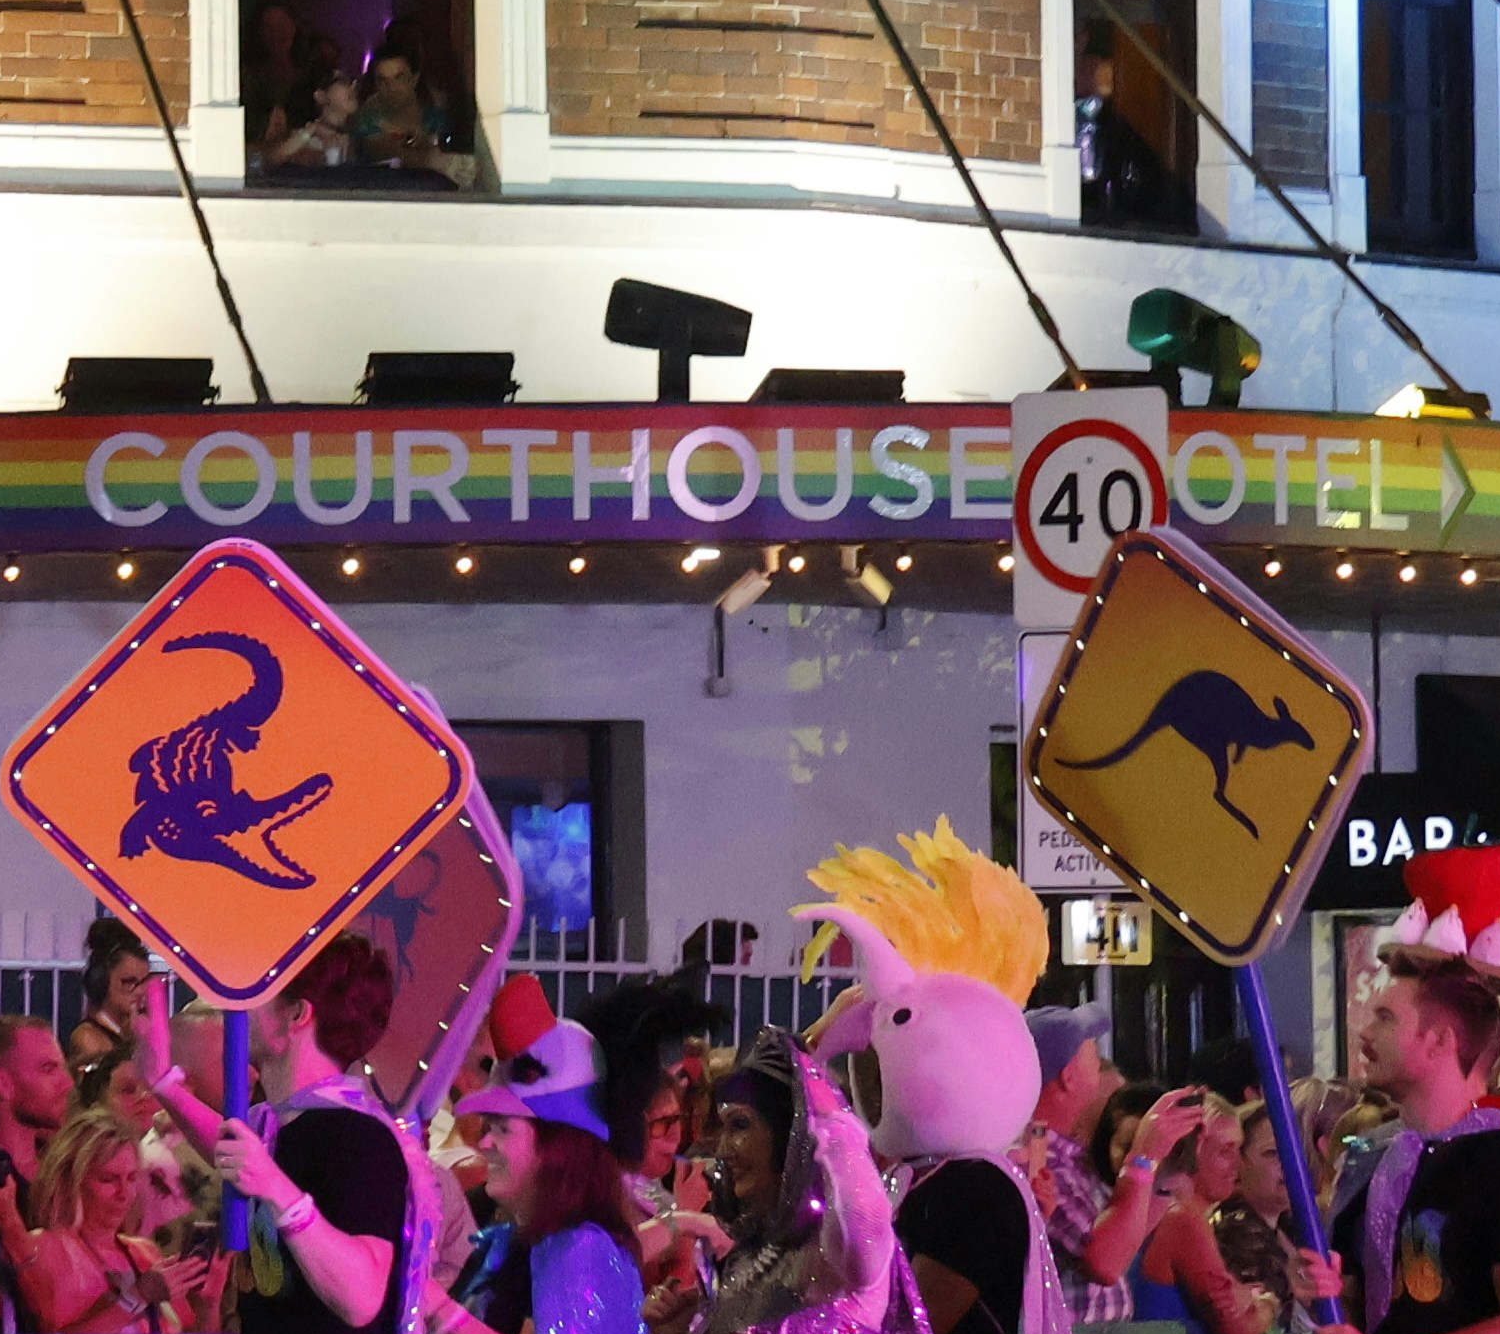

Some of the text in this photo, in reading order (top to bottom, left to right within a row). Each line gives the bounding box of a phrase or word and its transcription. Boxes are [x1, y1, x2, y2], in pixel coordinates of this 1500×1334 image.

[86, 424, 1410, 531] COURTHOUSE OTEL
[1039, 469, 1141, 543] 40
[1348, 816, 1455, 867] BAR
